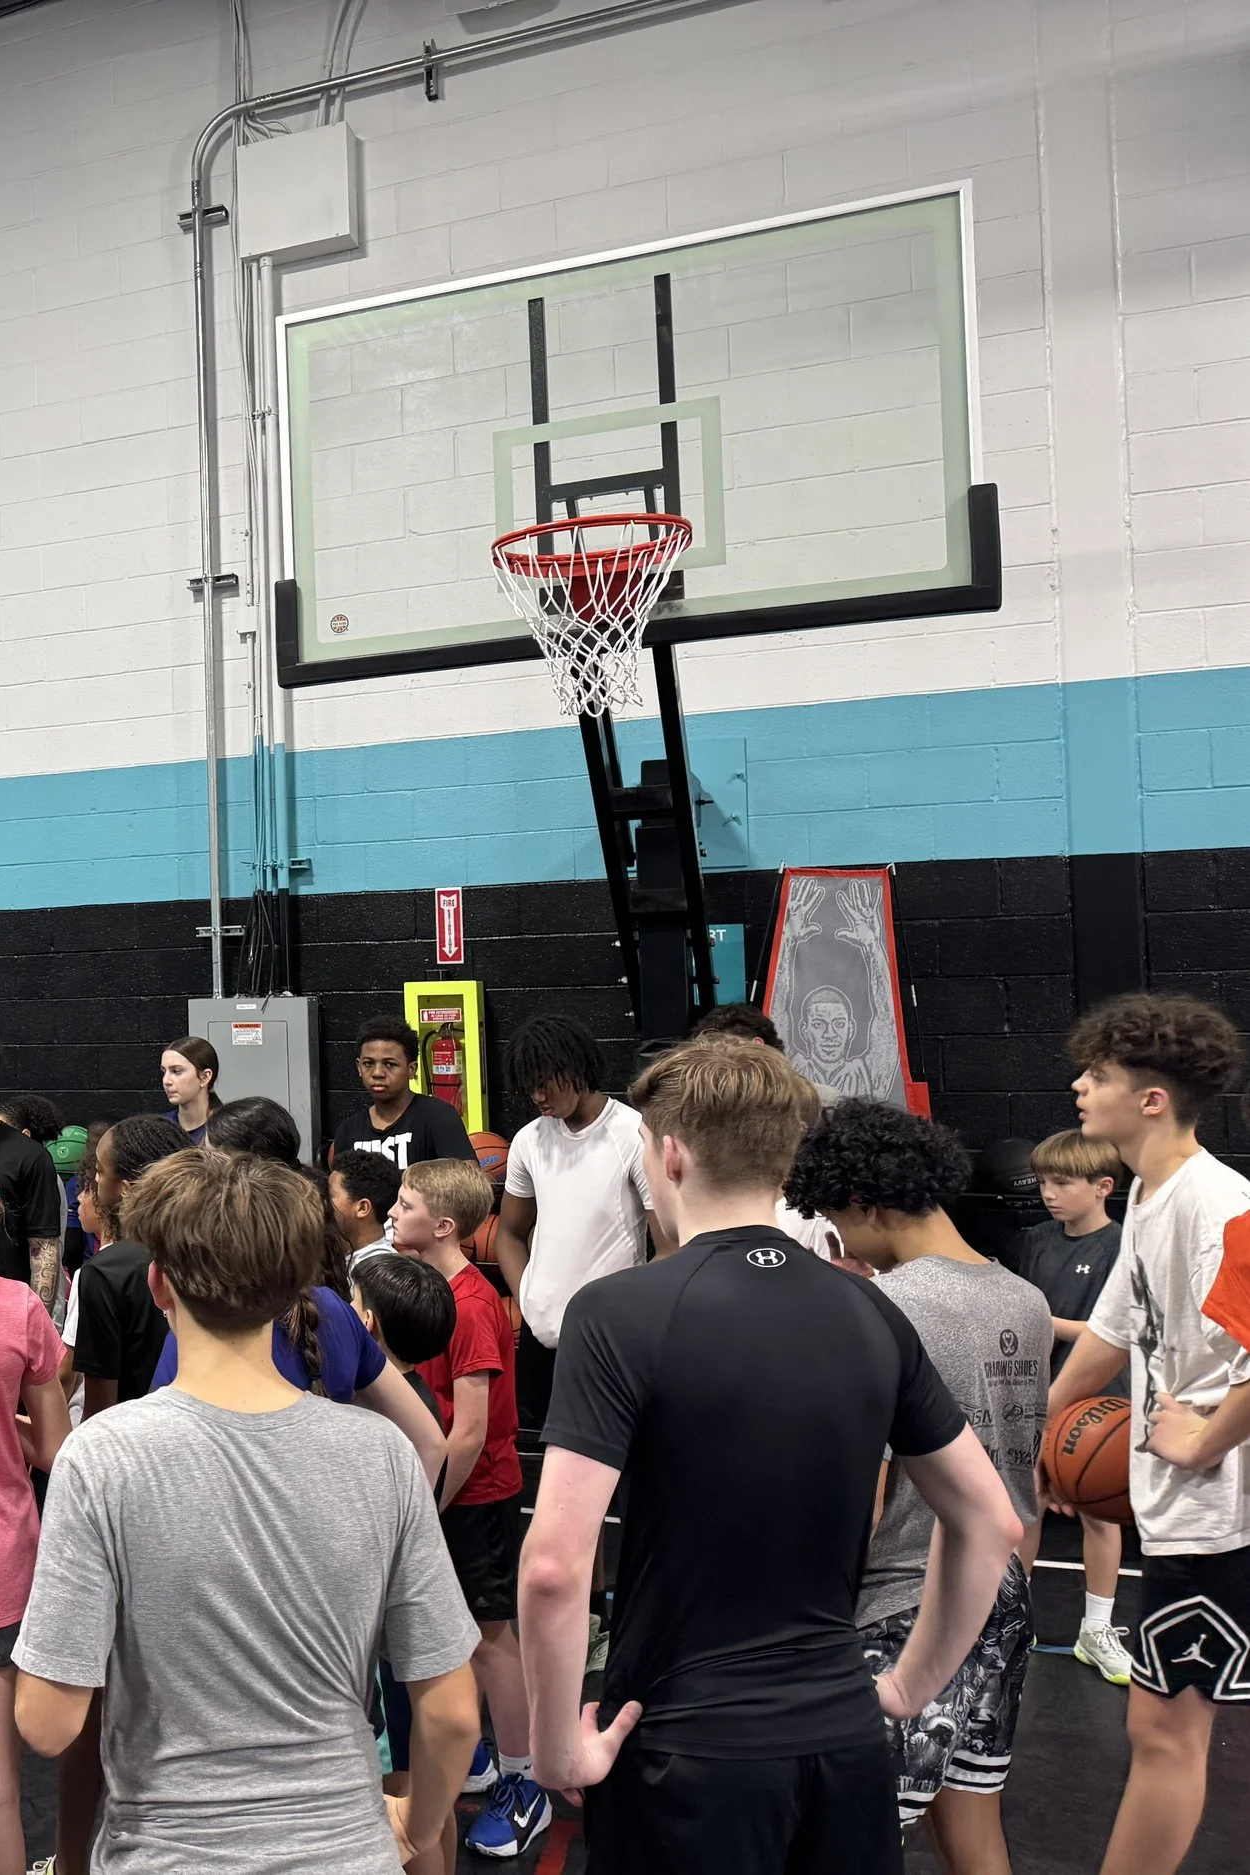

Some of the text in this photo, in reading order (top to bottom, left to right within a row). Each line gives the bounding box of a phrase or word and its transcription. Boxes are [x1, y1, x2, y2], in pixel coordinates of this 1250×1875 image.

[353, 1131, 412, 1170] ST
[1013, 1176, 1037, 1187] HEAVY
[1014, 1360, 1038, 1377] SHOES
